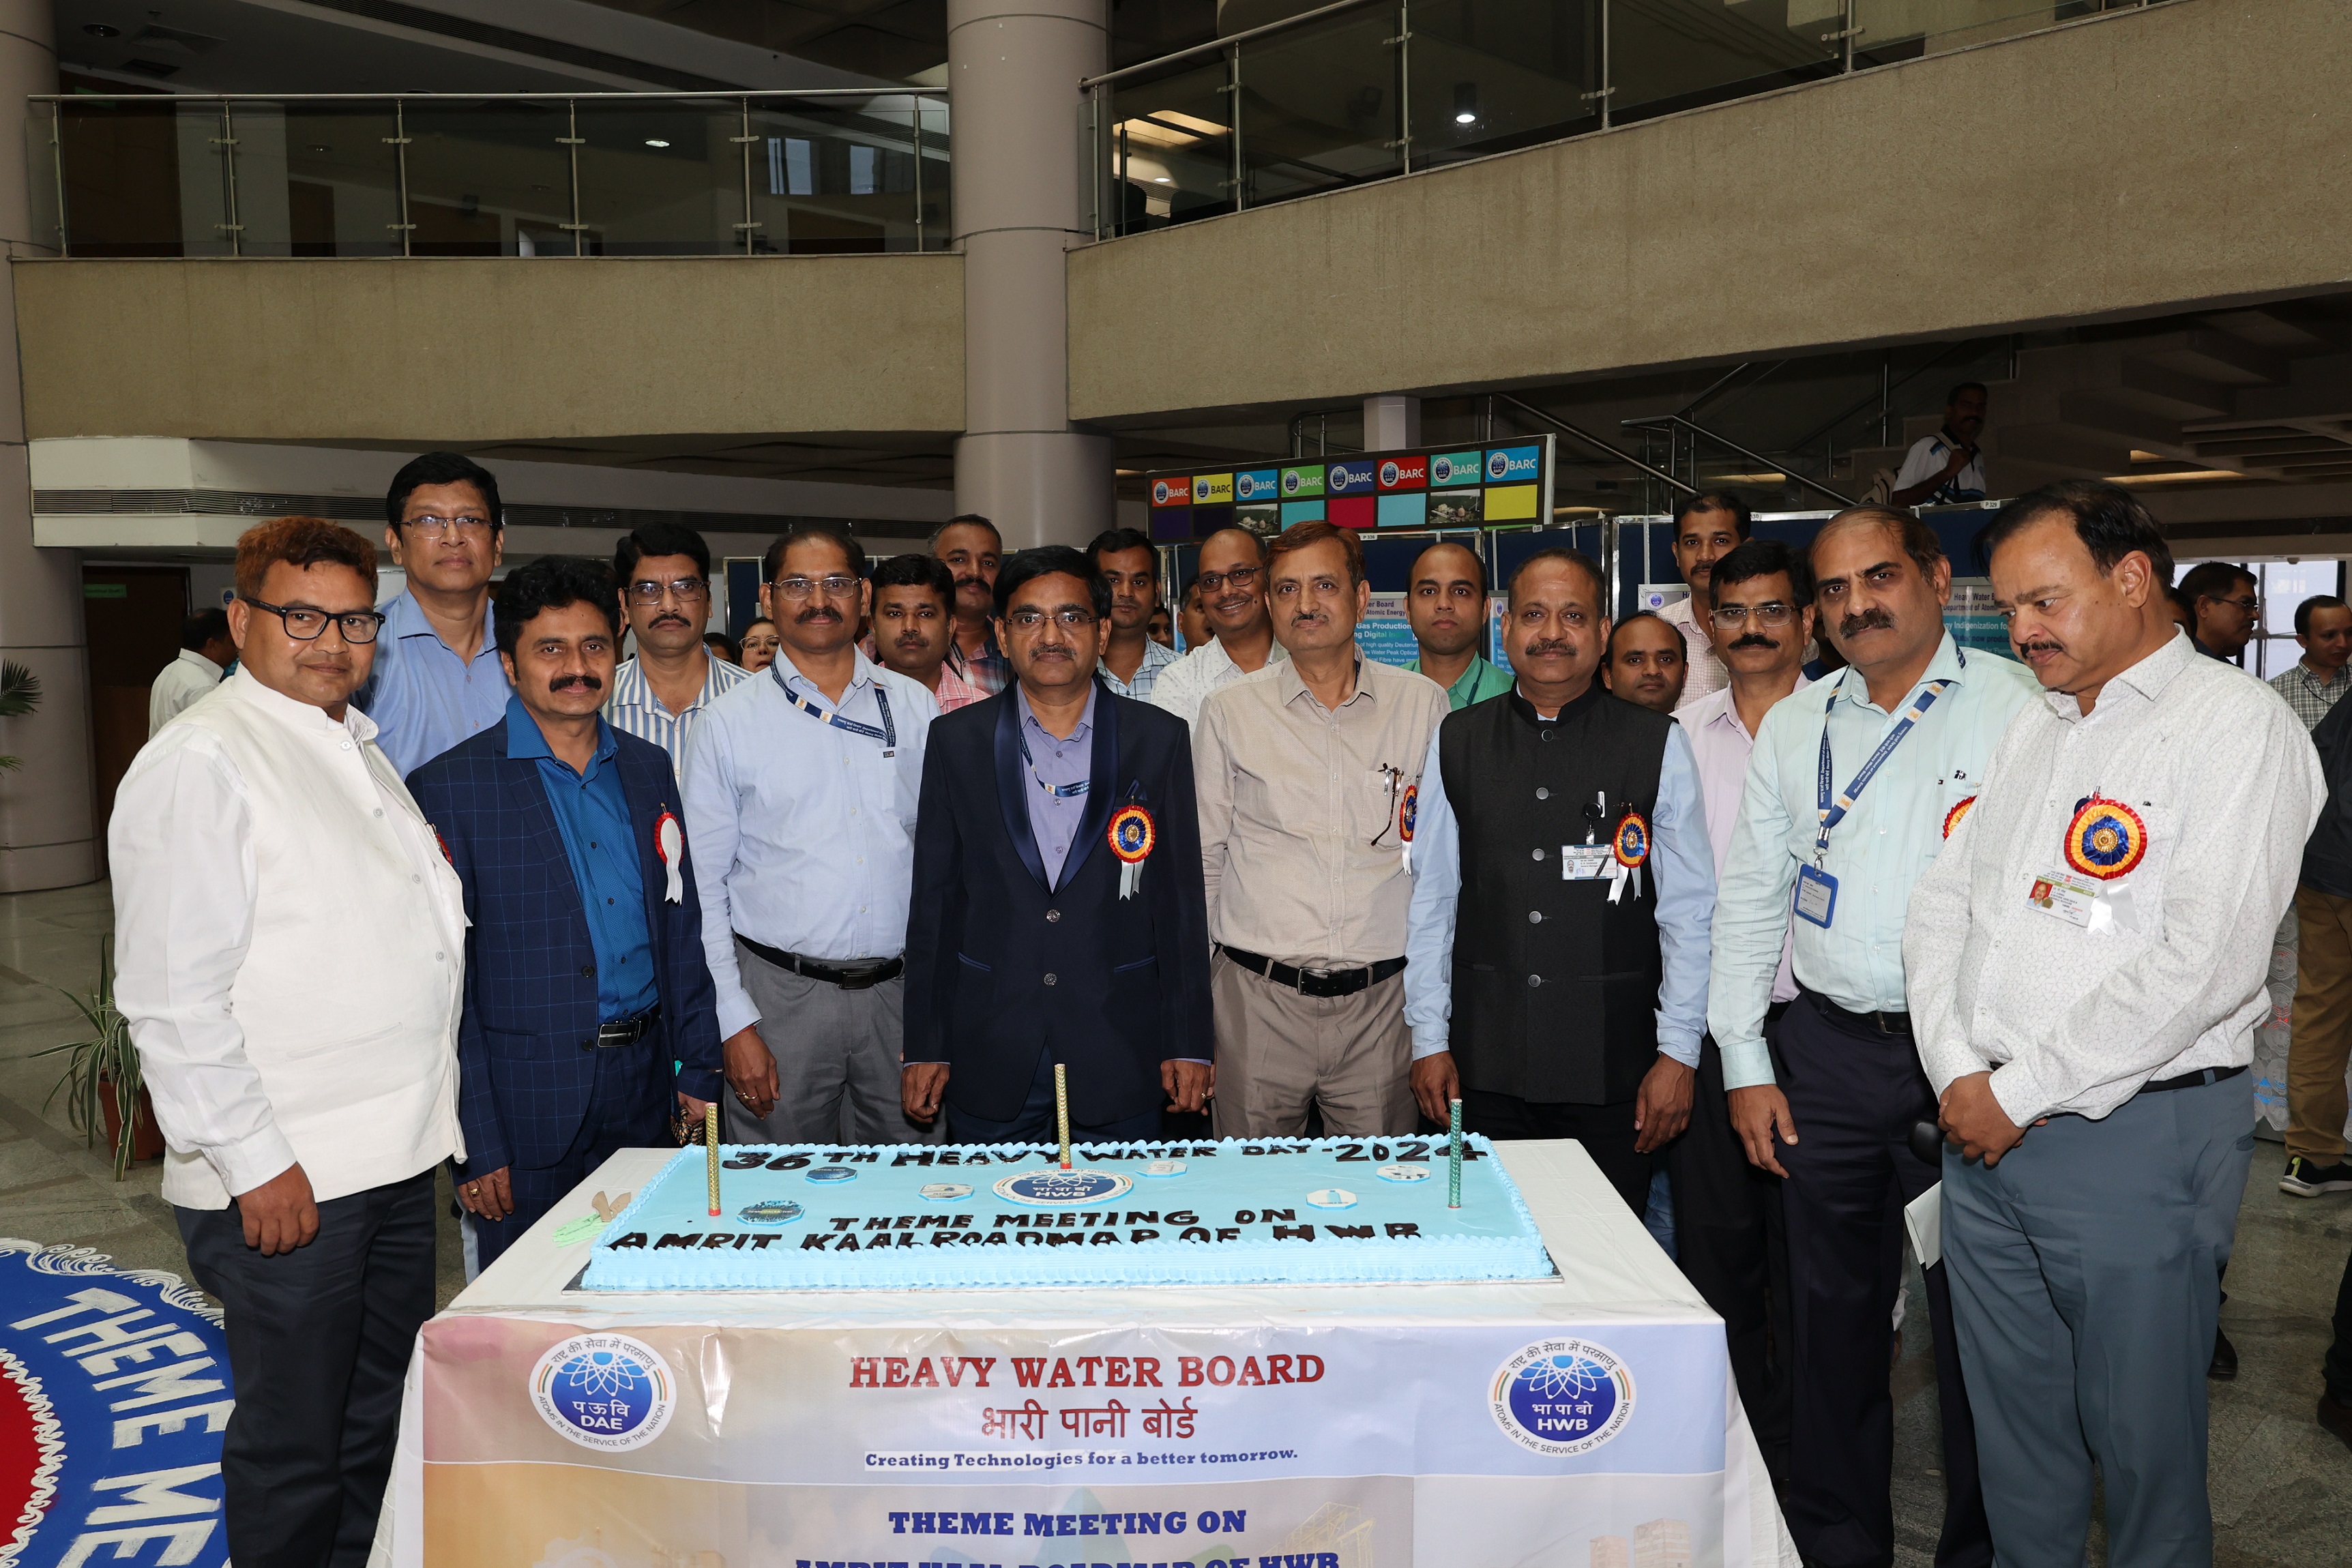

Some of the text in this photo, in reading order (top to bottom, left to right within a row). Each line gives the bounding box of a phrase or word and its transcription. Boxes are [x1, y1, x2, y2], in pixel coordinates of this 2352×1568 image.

[1453, 464, 1479, 475] BARC
[1509, 458, 1536, 471] BARC
[1300, 476, 1322, 486] BARC
[1349, 472, 1372, 483] BARC
[1399, 468, 1424, 479] BARC
[1169, 488, 1188, 497] BARC
[1211, 484, 1231, 494] BARC
[1254, 480, 1276, 490] BARC
[1973, 593, 1990, 601] Water
[1954, 621, 1999, 630] Indigenization
[1364, 631, 1387, 639] Digital
[1857, 752, 1880, 780] Heavy Water Board
[1873, 751, 1887, 768] Department
[1862, 771, 1871, 782] Atomic
[1853, 782, 1864, 793] Energy
[1078, 1146, 1217, 1162] WATER
[829, 1209, 1296, 1231] THEME MEETING ON
[603, 1232, 783, 1251] AMRIT
[1179, 1227, 1241, 1243] OF
[568, 1342, 583, 1355] की
[585, 1337, 607, 1349] सेवा
[610, 1337, 622, 1349] में
[623, 1342, 658, 1370] परमाणु
[1525, 1346, 1542, 1358] की
[1542, 1342, 1565, 1352] सेवा
[1568, 1340, 1581, 1352] में
[1582, 1344, 1618, 1371] परमाणु
[9, 1287, 237, 1449] THEME
[849, 1354, 1325, 1388] HEAVY WATER BOARD
[572, 1399, 631, 1417] प ऊ वि
[1531, 1400, 1593, 1415] भा पा बो
[538, 1395, 666, 1447] ATOMS IN THE SERVICE OF THE NATION
[580, 1417, 623, 1430] DAE
[981, 1396, 1198, 1441] भारी पानी बोर्ड
[1537, 1418, 1589, 1431] HWB
[1494, 1402, 1630, 1454] ATOMS IN THE SERVICE OF THE NATION
[866, 1449, 1298, 1469] Creating Technologies for a better tomorrow.
[889, 1510, 1247, 1537] THEME MEETING ON
